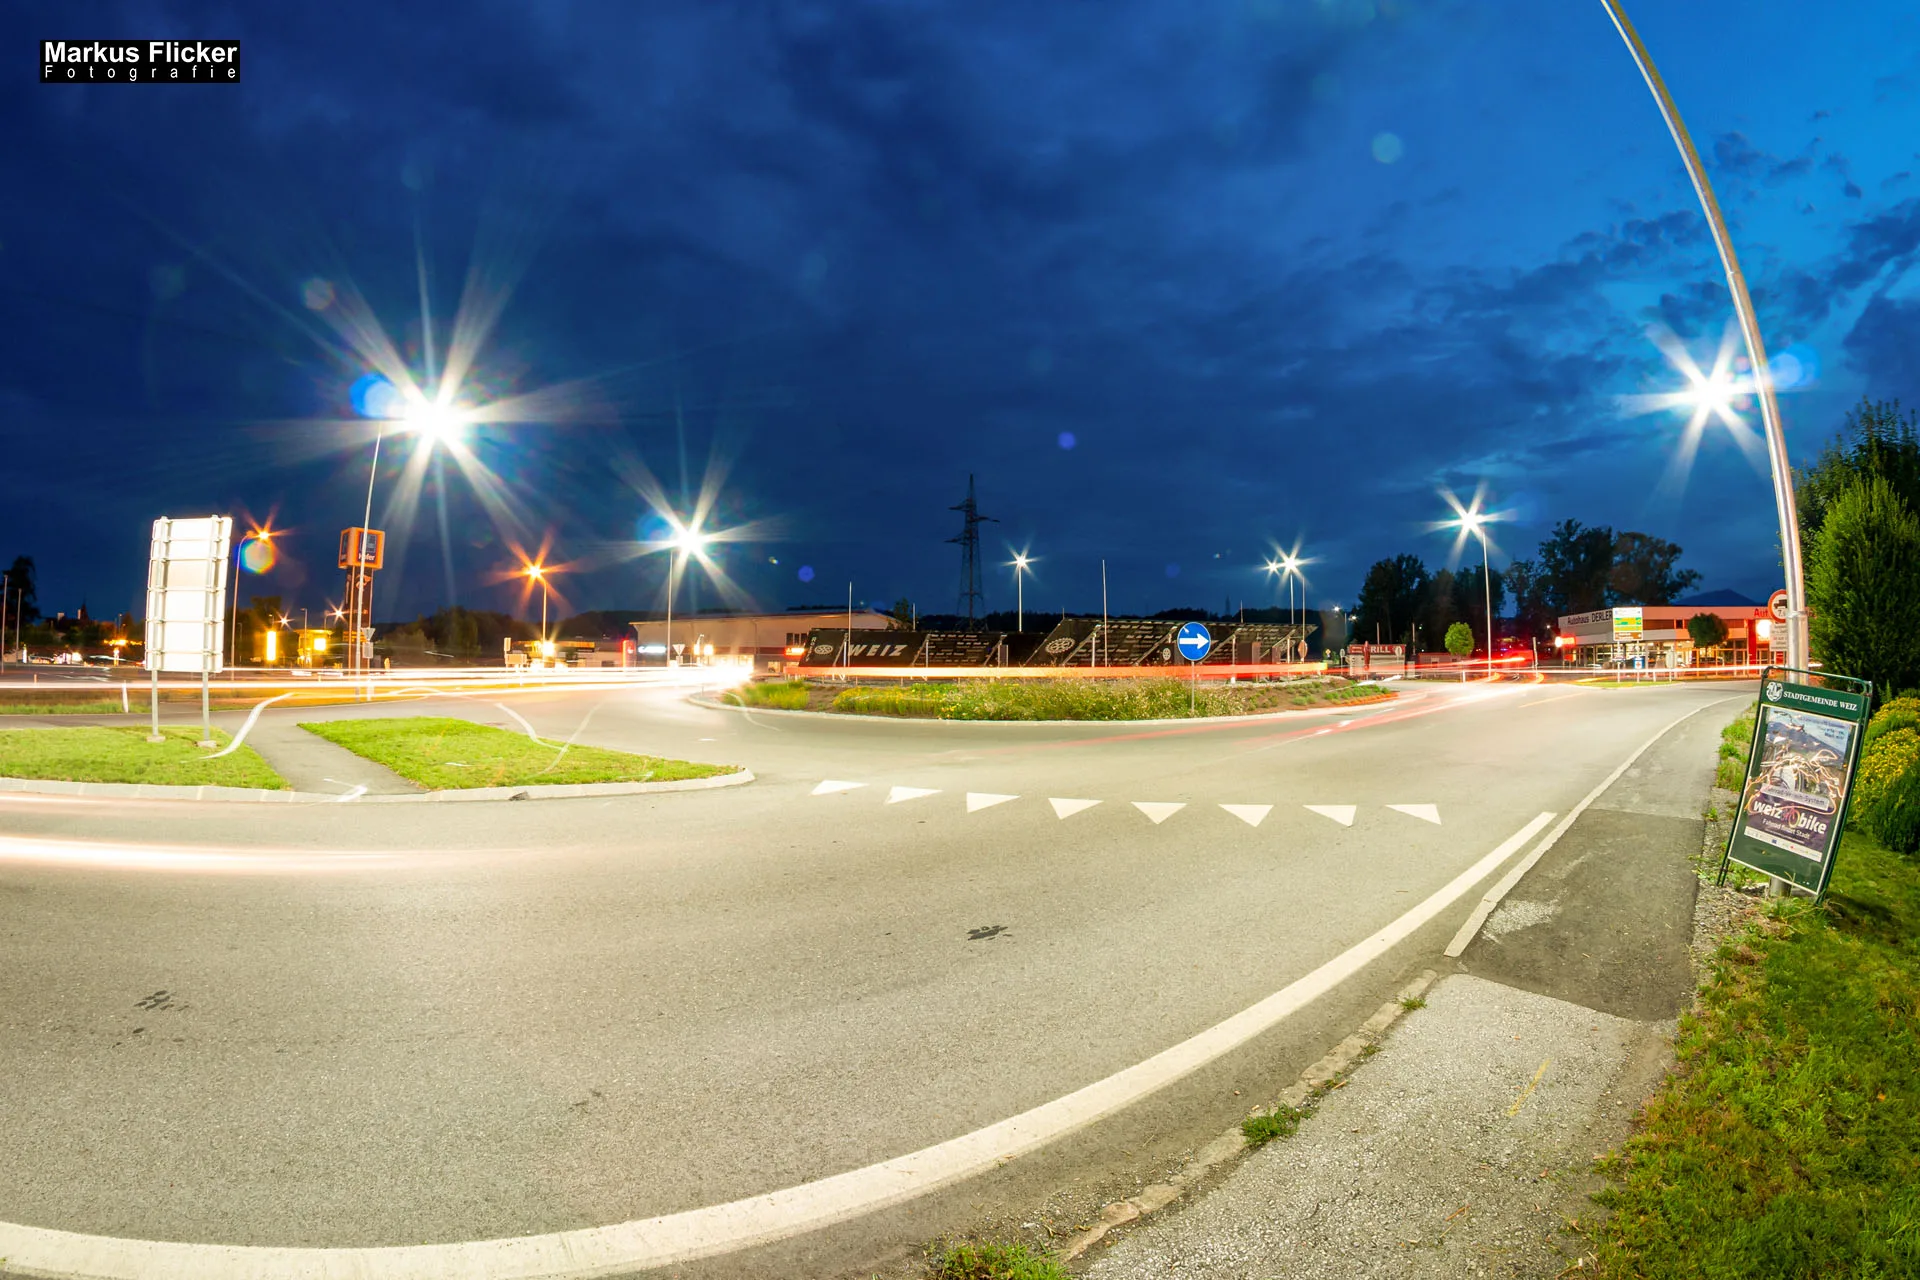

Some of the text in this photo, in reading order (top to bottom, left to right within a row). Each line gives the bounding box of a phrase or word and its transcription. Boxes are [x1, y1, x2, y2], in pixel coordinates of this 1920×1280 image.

[1567, 614, 1590, 624] Autohaus
[848, 644, 908, 657] WEIZ
[1783, 691, 1858, 711] STADTGEMEINDE WEIZ
[1797, 812, 1827, 834] bike
